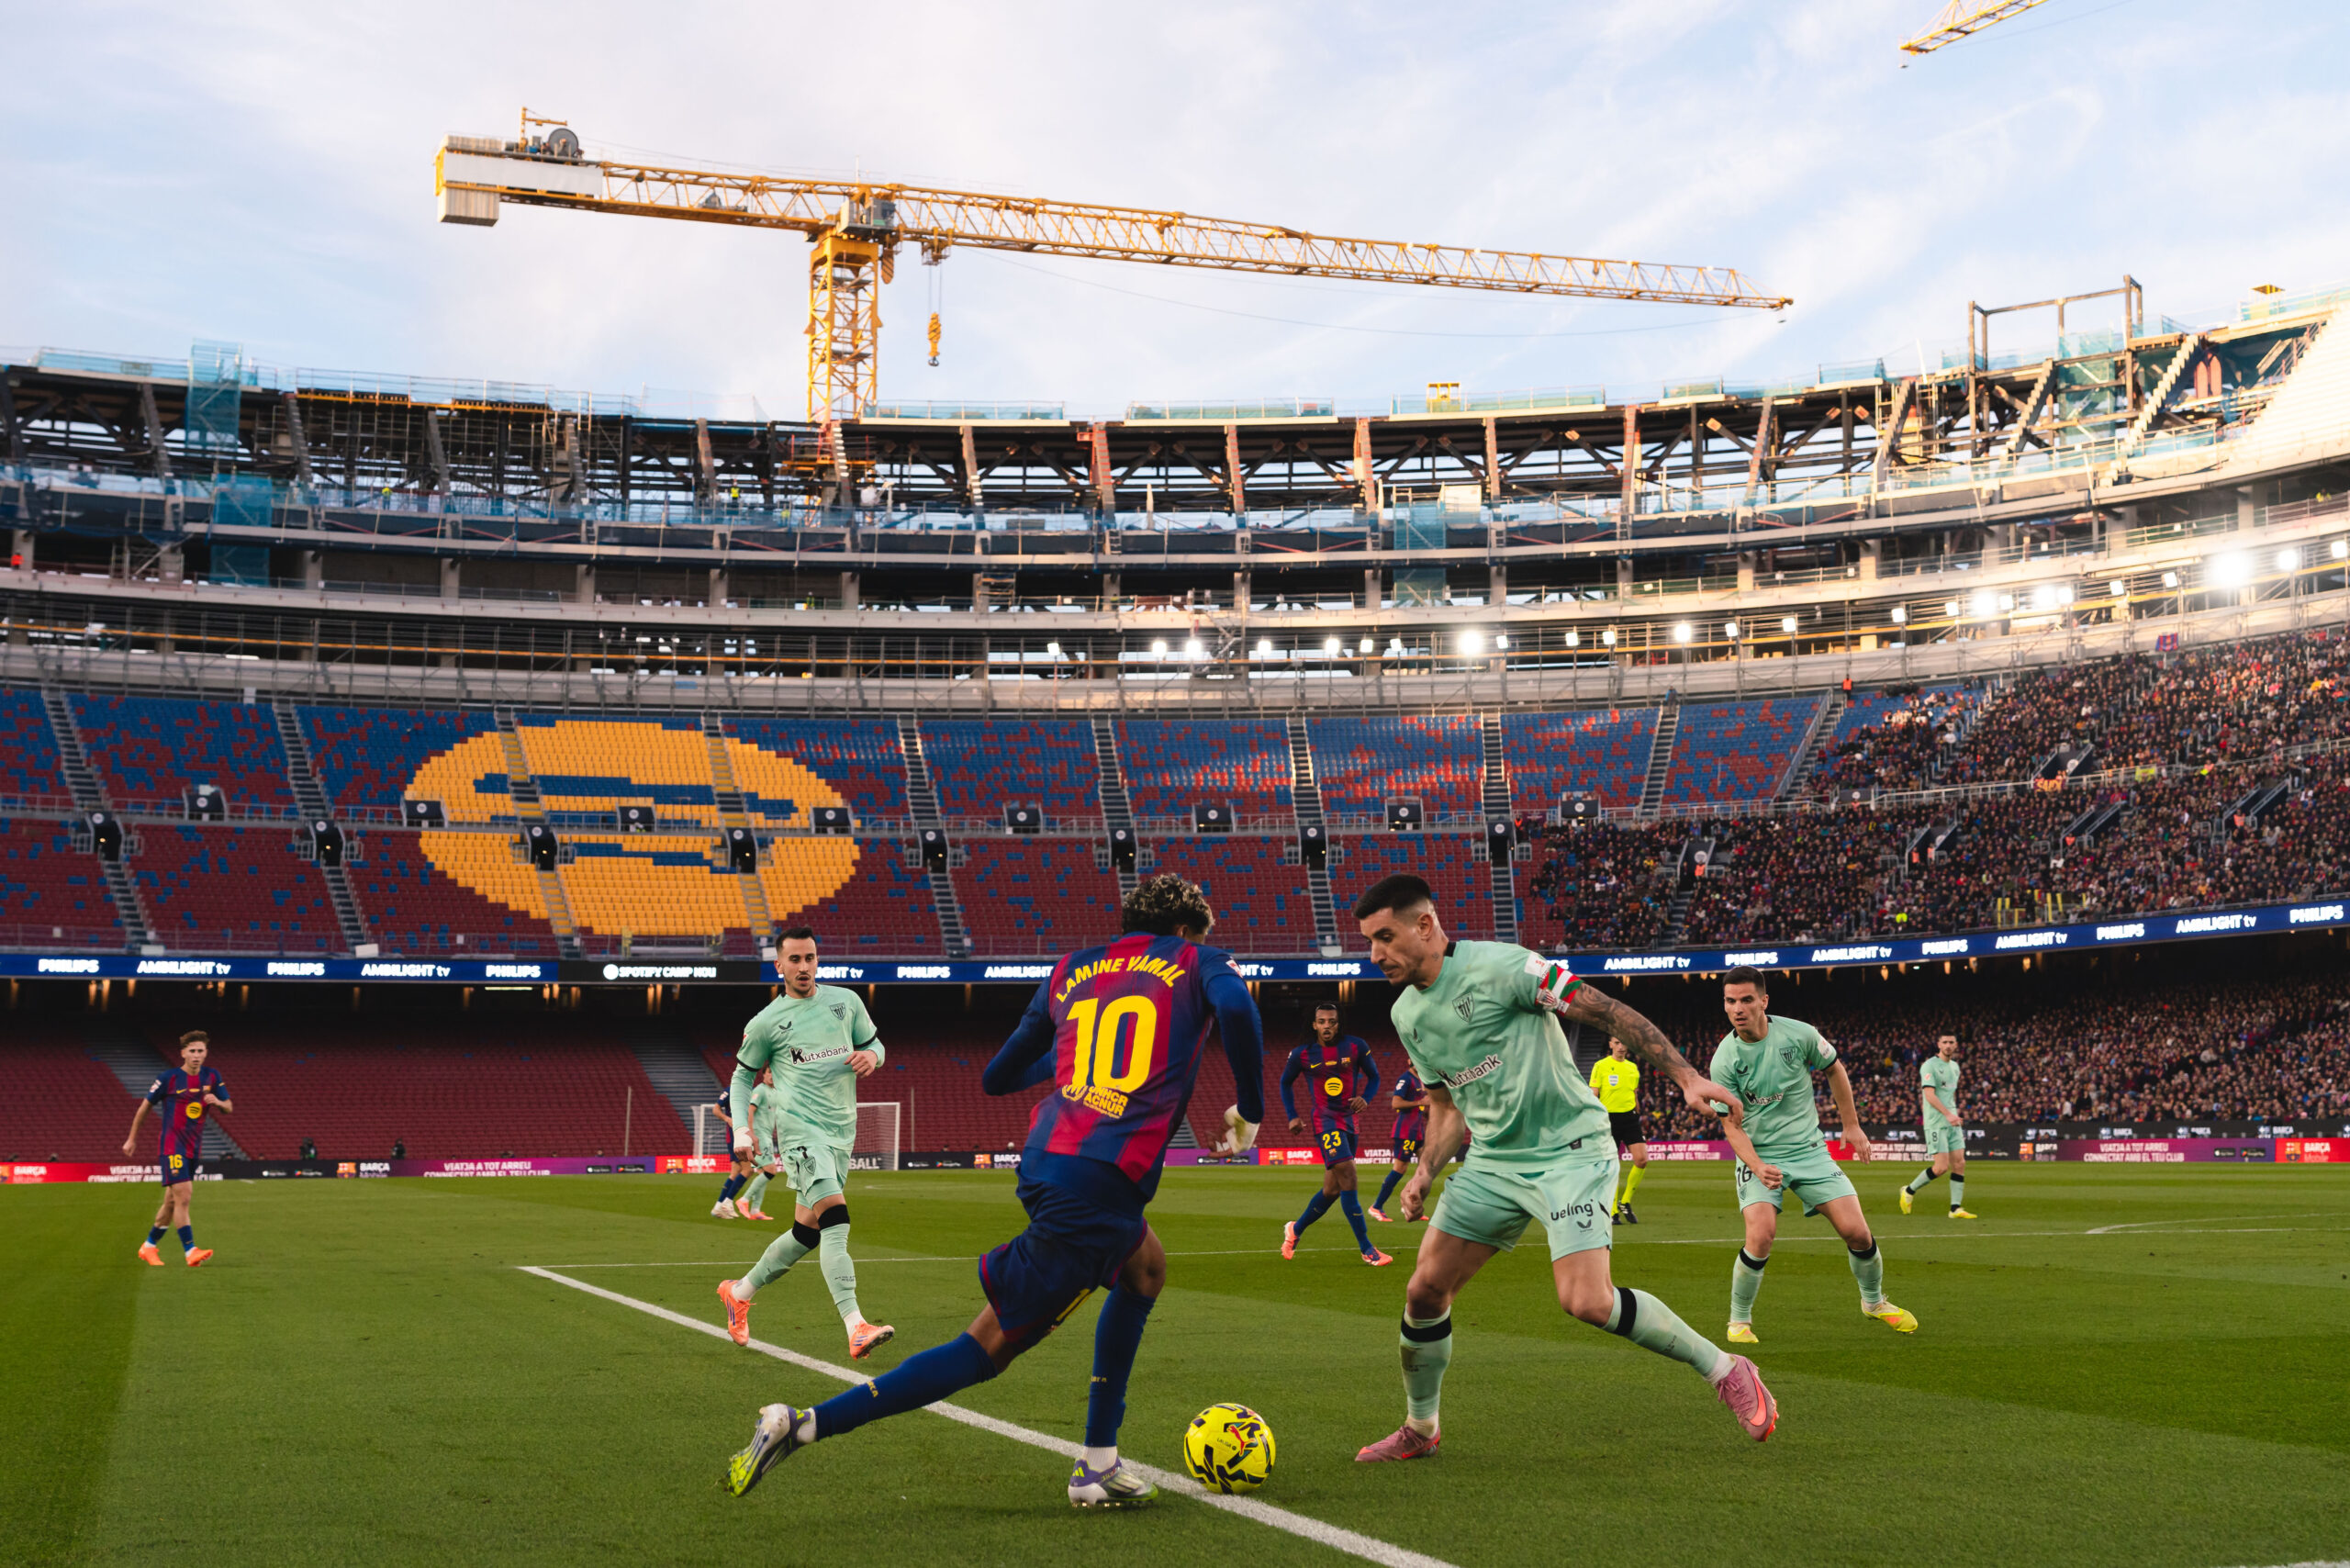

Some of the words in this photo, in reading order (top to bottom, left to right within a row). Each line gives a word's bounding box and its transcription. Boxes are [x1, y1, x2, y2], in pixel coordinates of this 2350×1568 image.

[2290, 905, 2344, 924] PHILIPS
[2176, 914, 2243, 934] AMBILIGHT
[2244, 915, 2257, 927] tv
[2097, 924, 2144, 941] PHILIPS
[1922, 939, 1968, 955] PHILIPS
[1996, 932, 2054, 949] AMBILIGHT
[2055, 932, 2067, 945] tv
[1725, 952, 1778, 966] PHILIPS
[1811, 946, 1878, 962] AMBILIGHT
[1879, 946, 1892, 958] tv
[38, 958, 100, 973] PHILIPS
[137, 960, 215, 974] AMBILIGHT
[216, 962, 231, 974] tv
[267, 962, 325, 976] PHILIPS
[361, 964, 435, 977] AMBILIGHT
[436, 965, 451, 977] tv
[1260, 965, 1273, 976] tv
[1307, 963, 1360, 975] PHILIPS
[1605, 957, 1676, 970] AMBILIGHT
[1677, 958, 1691, 969] tv
[486, 965, 541, 978] PHILIPS
[619, 967, 662, 978] SPOTIFY
[663, 967, 693, 978] CAMP
[694, 967, 717, 978] NOU
[850, 968, 863, 978] tv
[897, 966, 950, 979] PHILIPS
[1056, 958, 1125, 1002] LAMINE
[1126, 955, 1186, 988] YAMAL
[1066, 995, 1157, 1093] 10
[790, 1045, 849, 1064] Kutxabank
[1084, 1092, 1125, 1116] ACNUR
[1322, 1130, 1341, 1149] 23
[1931, 1131, 1938, 1142] 8
[1403, 1140, 1416, 1151] 24
[168, 1154, 183, 1169] 16
[359, 1162, 390, 1171] BARÇA
[476, 1162, 483, 1170] A
[484, 1162, 500, 1170] TOT
[1737, 1165, 1752, 1187] 16
[1550, 1201, 1594, 1221] ueling
